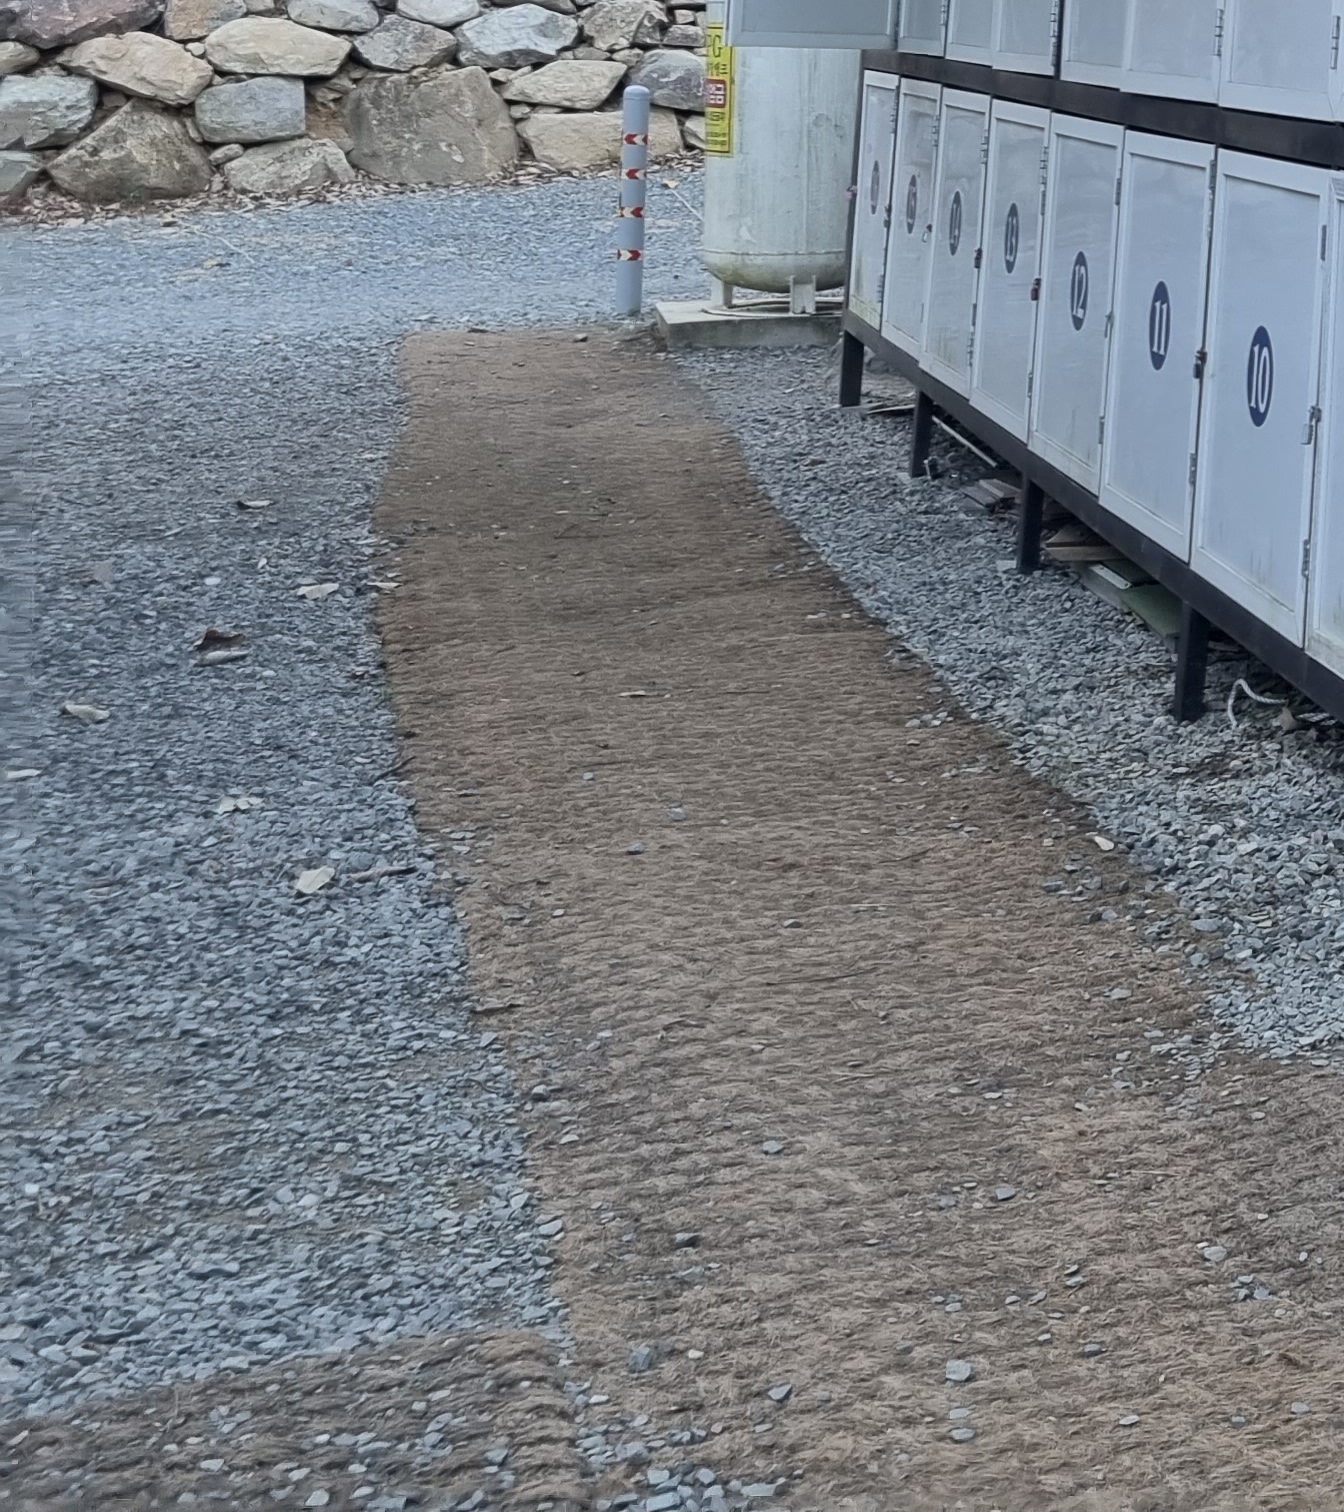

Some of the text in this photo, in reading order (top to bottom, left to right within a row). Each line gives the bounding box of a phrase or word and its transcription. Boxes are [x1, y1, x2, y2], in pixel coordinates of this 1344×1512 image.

[1072, 264, 1086, 319] 12
[1152, 300, 1168, 356] 11
[1250, 344, 1270, 414] 10
